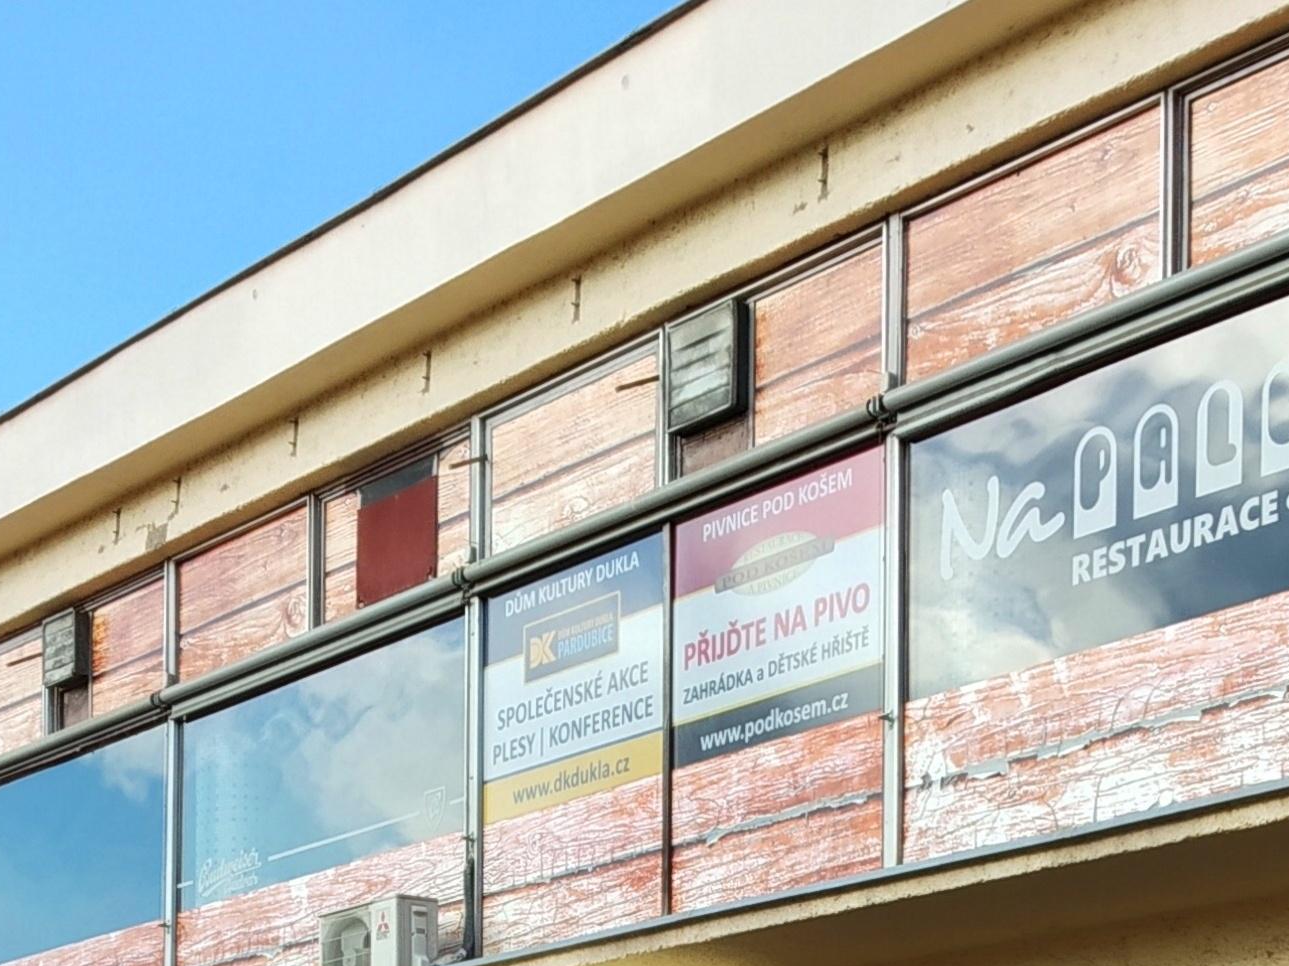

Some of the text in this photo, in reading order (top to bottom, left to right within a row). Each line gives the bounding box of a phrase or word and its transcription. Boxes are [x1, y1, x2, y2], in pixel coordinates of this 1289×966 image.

[702, 467, 853, 544] PIVNICE POD KOŠEM
[940, 475, 1065, 581] Na
[1072, 490, 1280, 586] RESTAURACE
[505, 551, 640, 618] DŮM KULTURY DUKLA
[529, 630, 557, 670] DK
[557, 623, 614, 661] PARDUBICE
[684, 582, 871, 672] PŘIJĎTE NA PIVO
[497, 661, 649, 732] SPOLEČENSKÉ AKCE
[684, 625, 870, 706] ZAHRÁDKA a DĚTSKÉ HŘIŠTĚ
[492, 730, 536, 766] PLESY
[549, 695, 654, 749] KONFERENCE
[700, 691, 849, 753] www.podkosem.cz
[512, 755, 630, 805] www.dkdukla.cz
